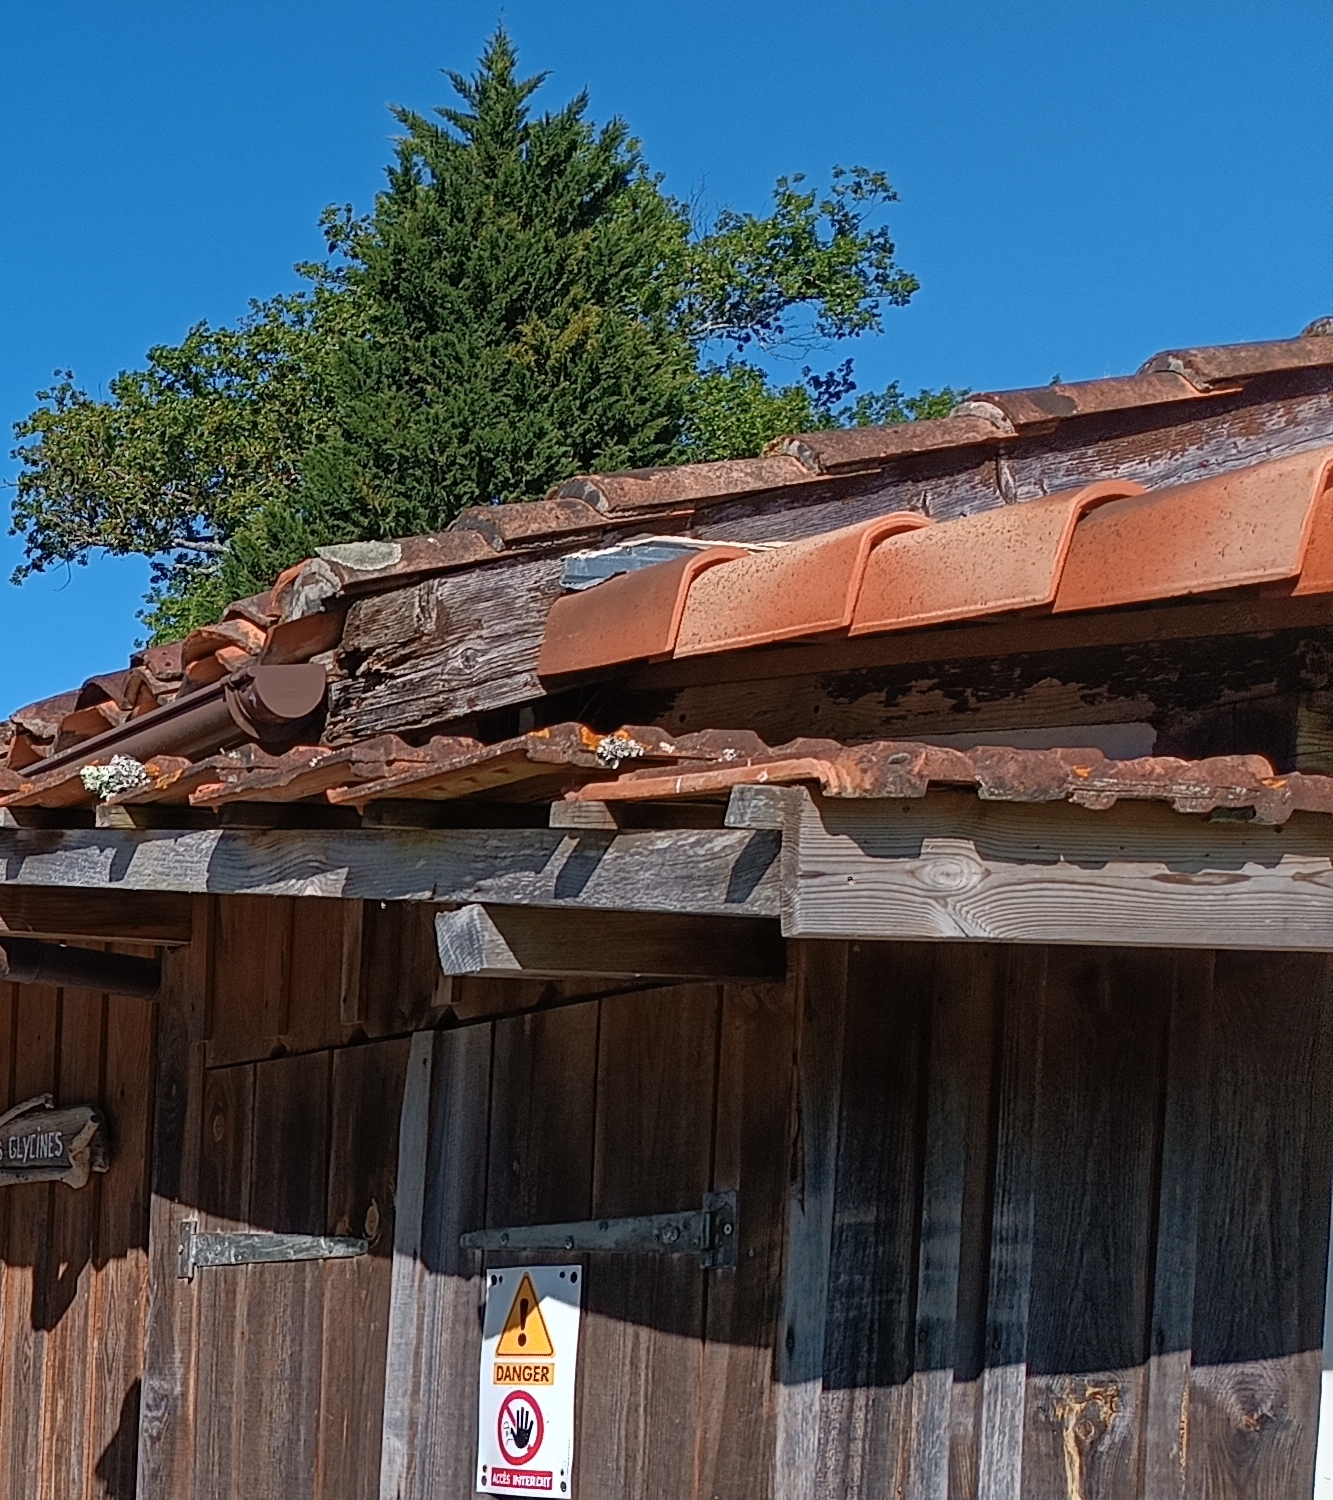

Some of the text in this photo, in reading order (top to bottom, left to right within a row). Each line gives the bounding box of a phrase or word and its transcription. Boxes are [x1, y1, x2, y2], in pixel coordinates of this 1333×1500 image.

[496, 1365, 549, 1382] DANGER
[492, 1471, 552, 1488] ACCÈS INTERDIT
